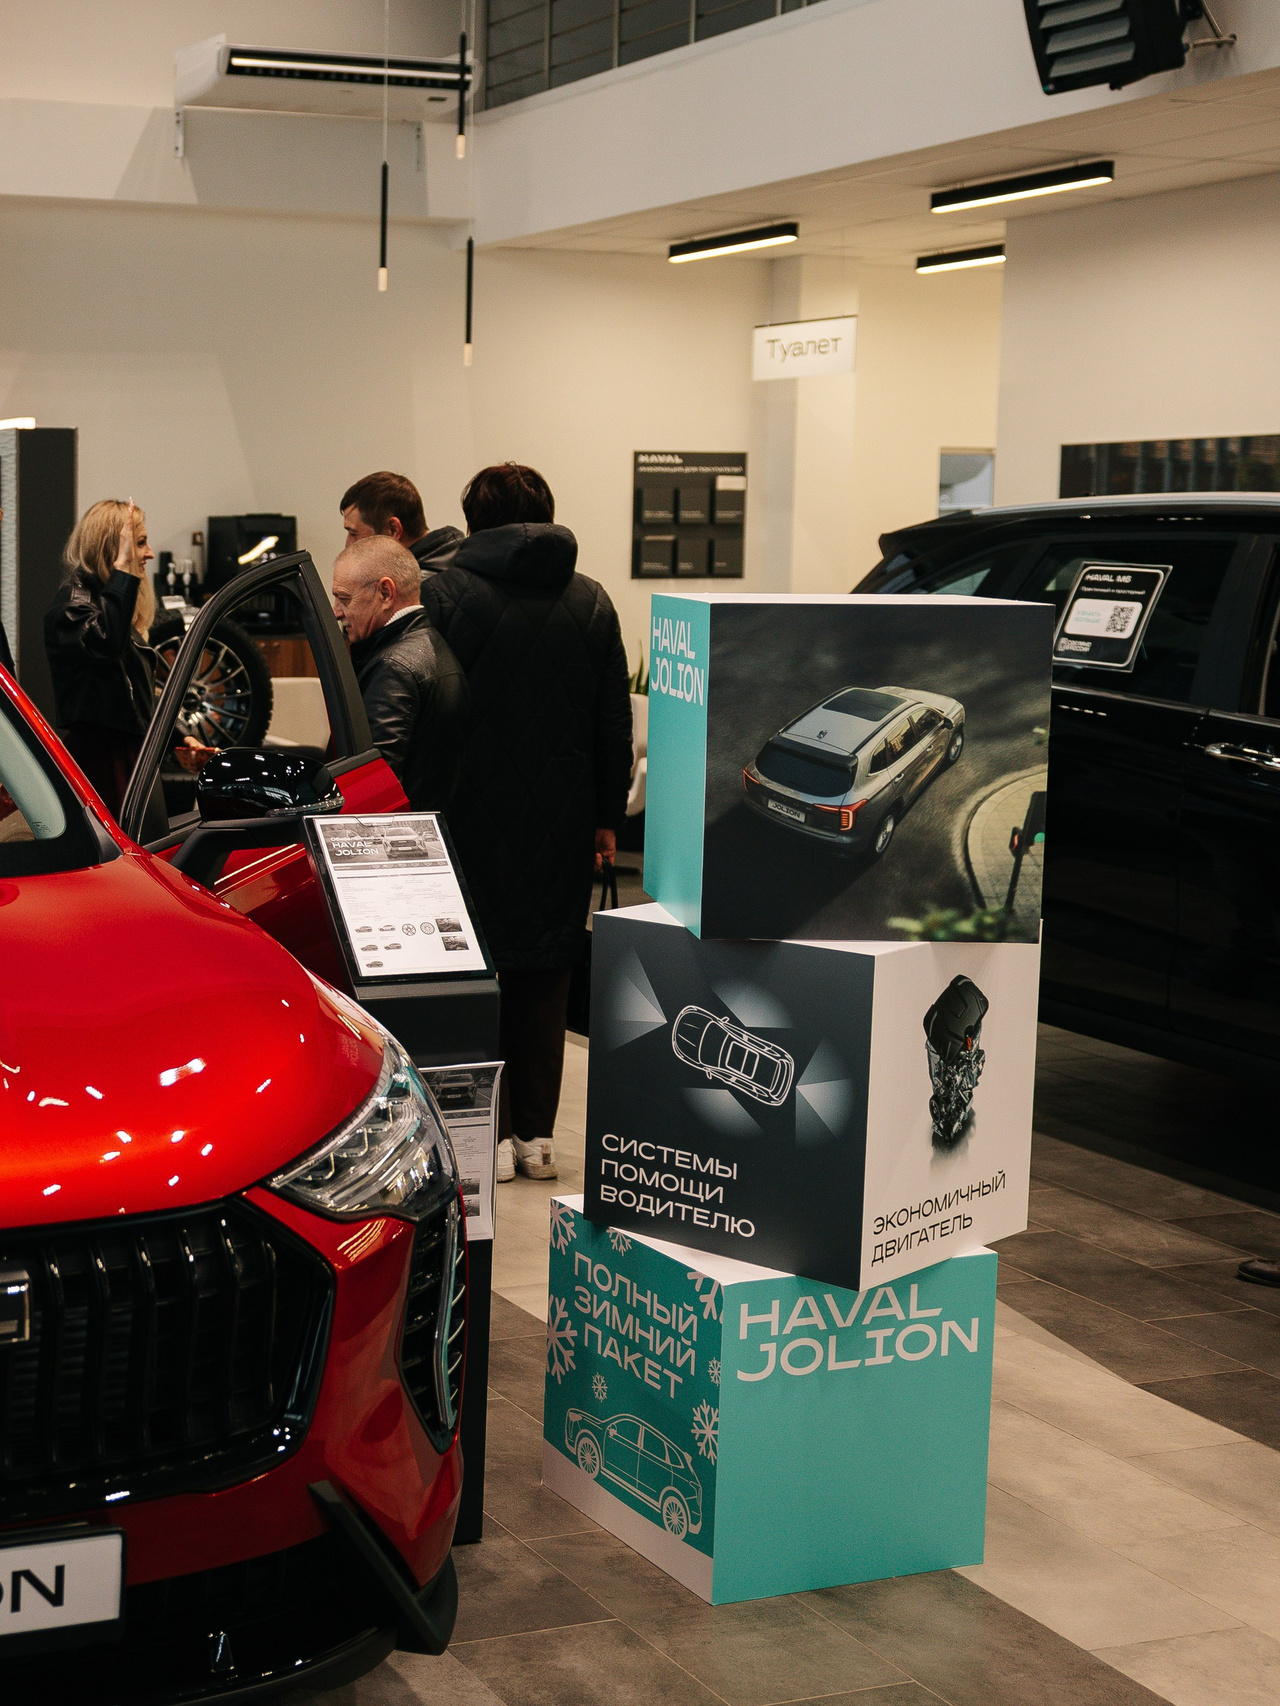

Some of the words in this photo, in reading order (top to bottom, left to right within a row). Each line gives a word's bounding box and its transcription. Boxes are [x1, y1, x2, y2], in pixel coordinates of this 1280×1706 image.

[766, 336, 842, 363] Туалет
[1084, 573, 1115, 583] HAVAL
[652, 615, 695, 659] HAVAL
[651, 656, 704, 706] JOLION
[772, 802, 801, 819] JOLION
[332, 840, 373, 848] HAVAL
[335, 848, 379, 856] JOLION
[601, 1133, 738, 1180] СИСТЕМЫ
[601, 1159, 724, 1204] ПОМОЩИ
[600, 1184, 755, 1238] ВОДИТЕЛЮ
[872, 1169, 1007, 1236] ЭКОНОМИЧНЫЙ
[871, 1213, 973, 1267] ДВИГАТЕЛЬ
[573, 1251, 698, 1342] ПОЛНЫЙ
[739, 1282, 943, 1340] HAVAL
[573, 1287, 696, 1376] ЗИМНИЙ
[737, 1317, 979, 1382] JOLION
[583, 1321, 683, 1398] ПАКЕТ
